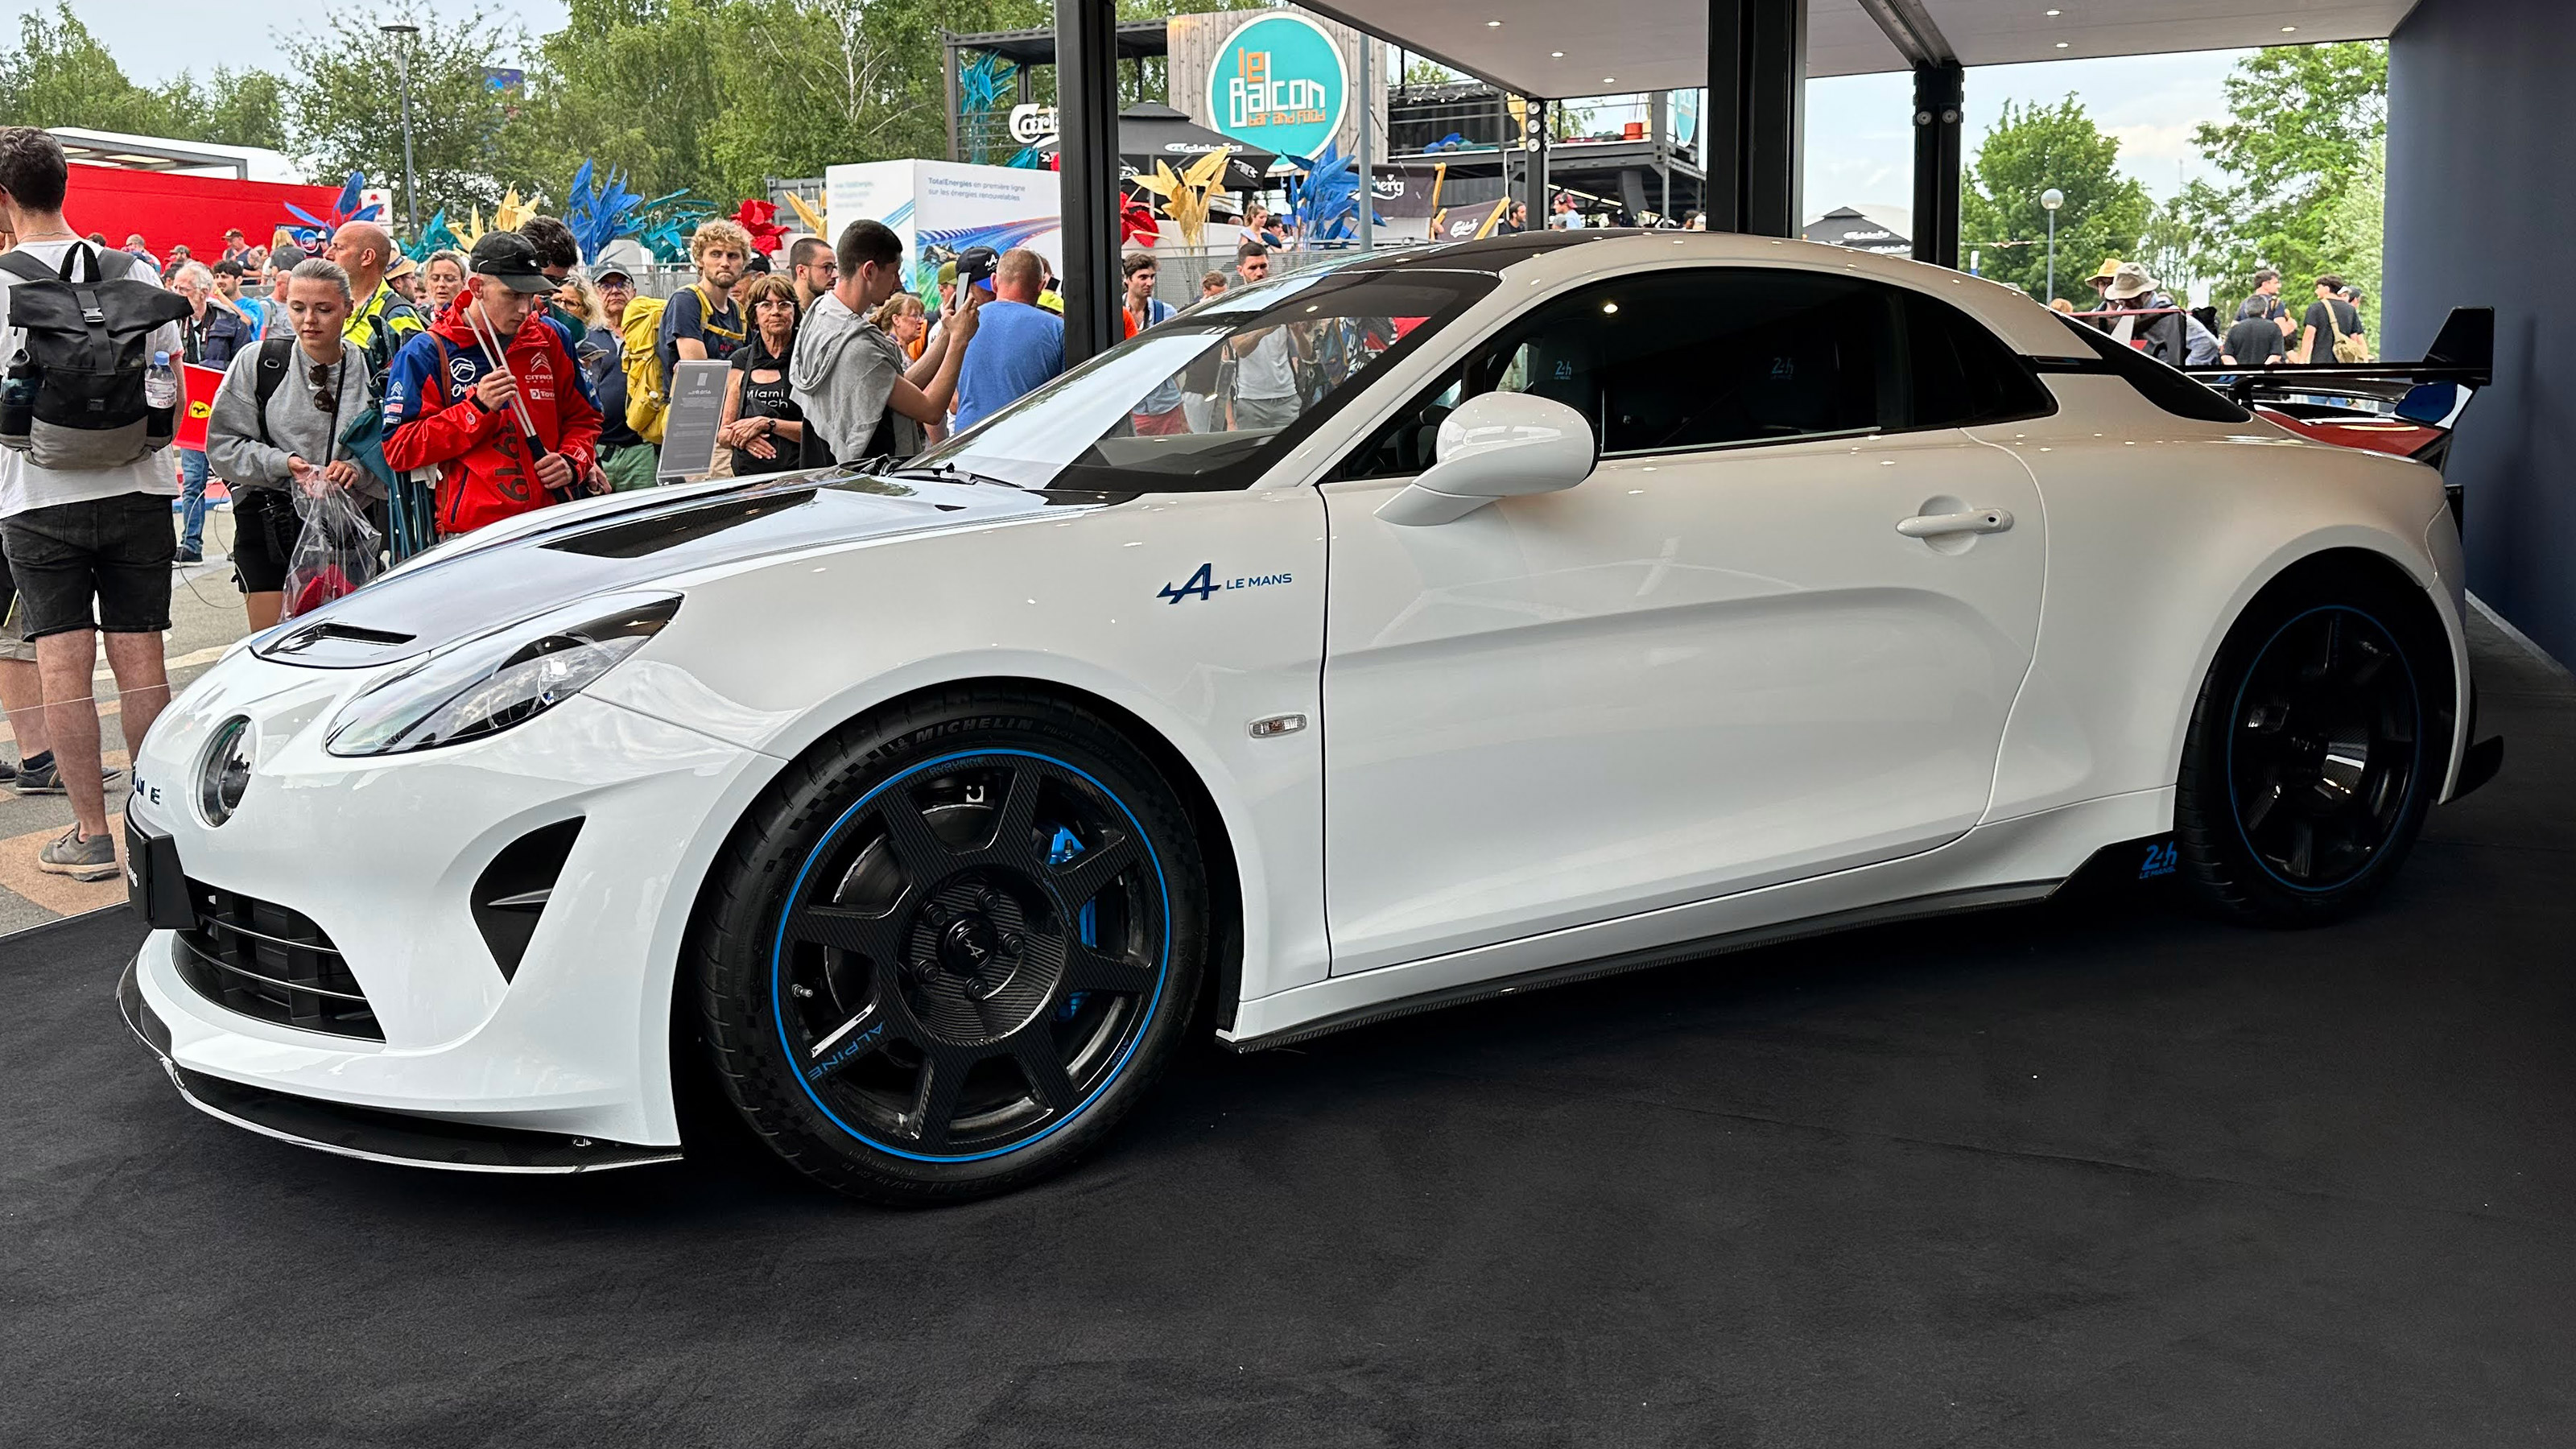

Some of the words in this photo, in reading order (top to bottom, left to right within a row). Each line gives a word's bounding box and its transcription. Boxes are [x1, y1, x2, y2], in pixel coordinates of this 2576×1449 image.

[1238, 47, 1265, 82] le
[1229, 51, 1326, 128] Balcon
[927, 177, 972, 188] TotalEnergies
[1226, 578, 1245, 590] LE
[1249, 573, 1293, 588] MANS
[914, 716, 1035, 745] MICHELIN
[807, 1021, 884, 1080] ALPINE
